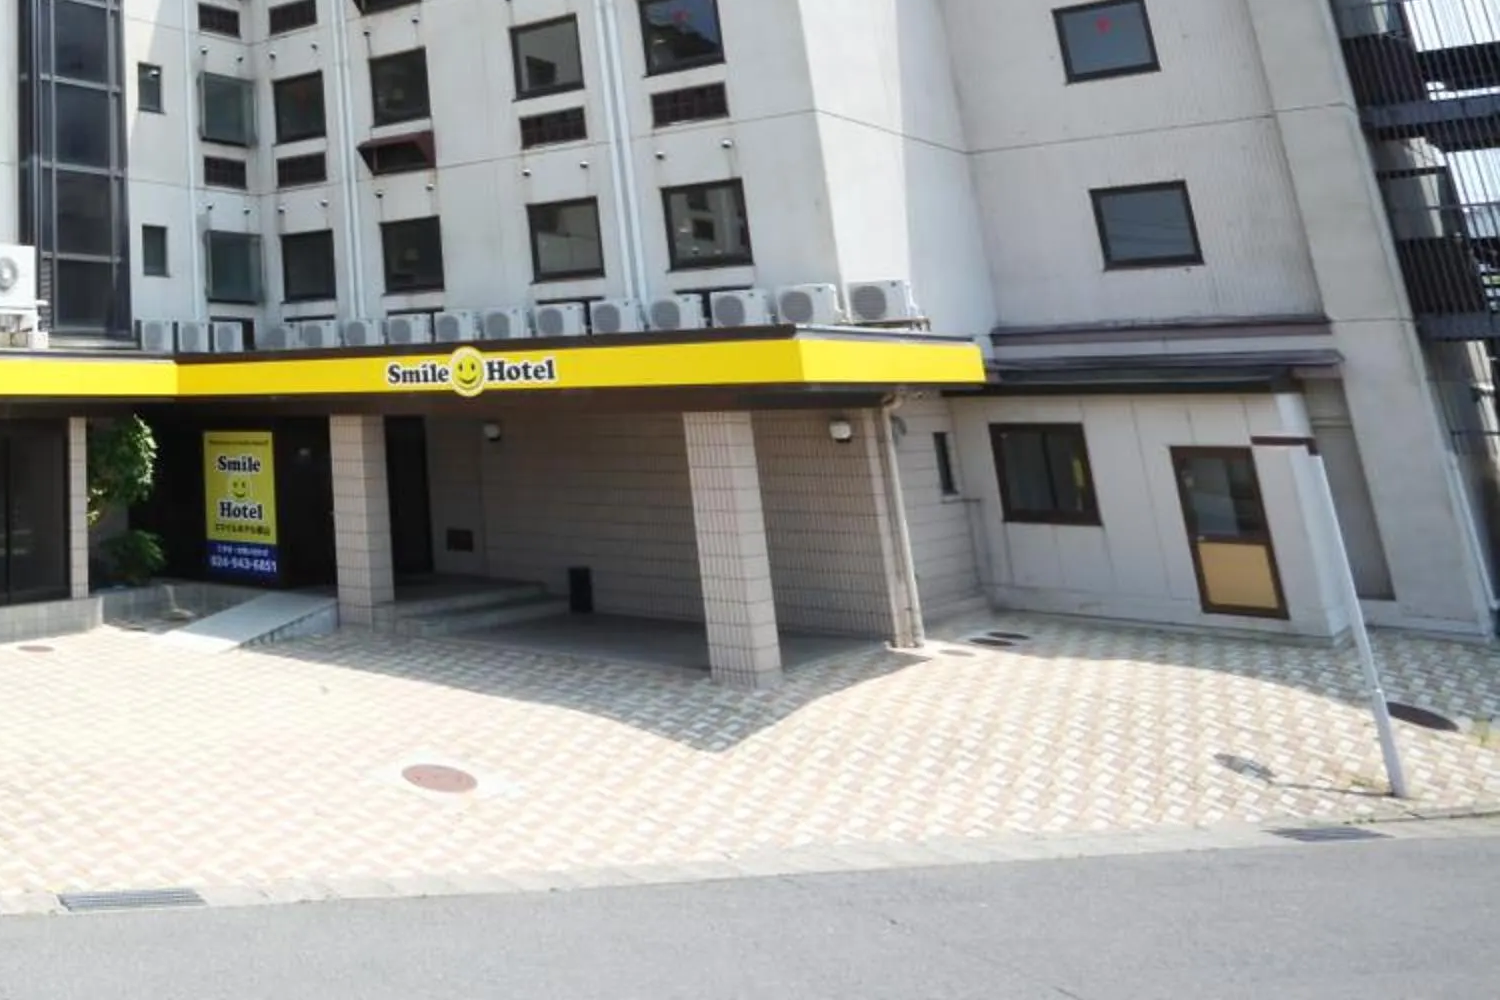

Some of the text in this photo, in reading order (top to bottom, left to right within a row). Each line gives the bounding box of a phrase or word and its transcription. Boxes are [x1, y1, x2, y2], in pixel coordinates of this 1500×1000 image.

[387, 359, 555, 384] Smile Hotel
[217, 456, 261, 472] Smile
[220, 502, 263, 520] Hotel
